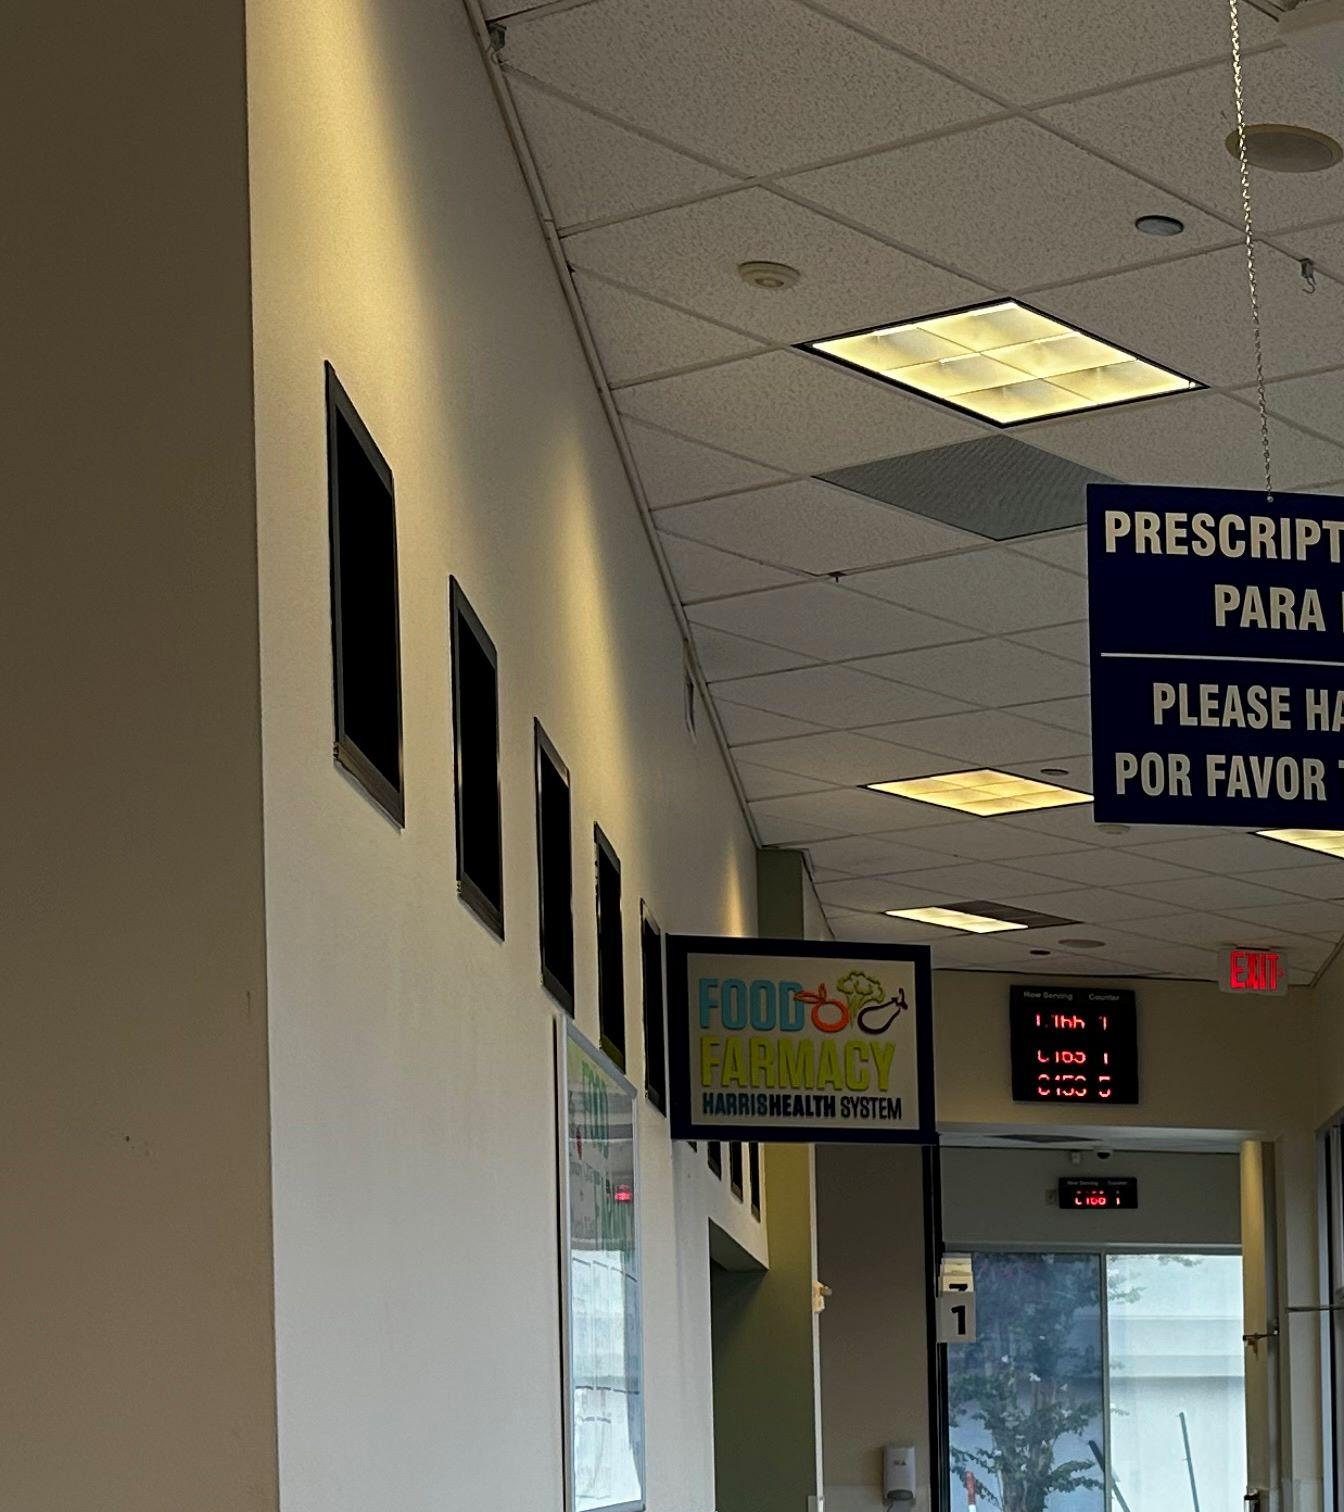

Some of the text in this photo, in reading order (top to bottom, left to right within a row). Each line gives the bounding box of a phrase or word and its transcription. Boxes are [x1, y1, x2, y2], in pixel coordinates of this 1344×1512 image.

[1214, 584, 1325, 631] PARA
[1153, 683, 1291, 729] PLEASE
[1115, 752, 1191, 796] POR
[1206, 754, 1326, 801] FAVOR
[1230, 949, 1280, 990] EXIT
[699, 978, 804, 1032] FOOD
[700, 1037, 897, 1092] FARMACY
[840, 1096, 902, 1121] SYSTEM
[951, 1305, 966, 1335] 1
